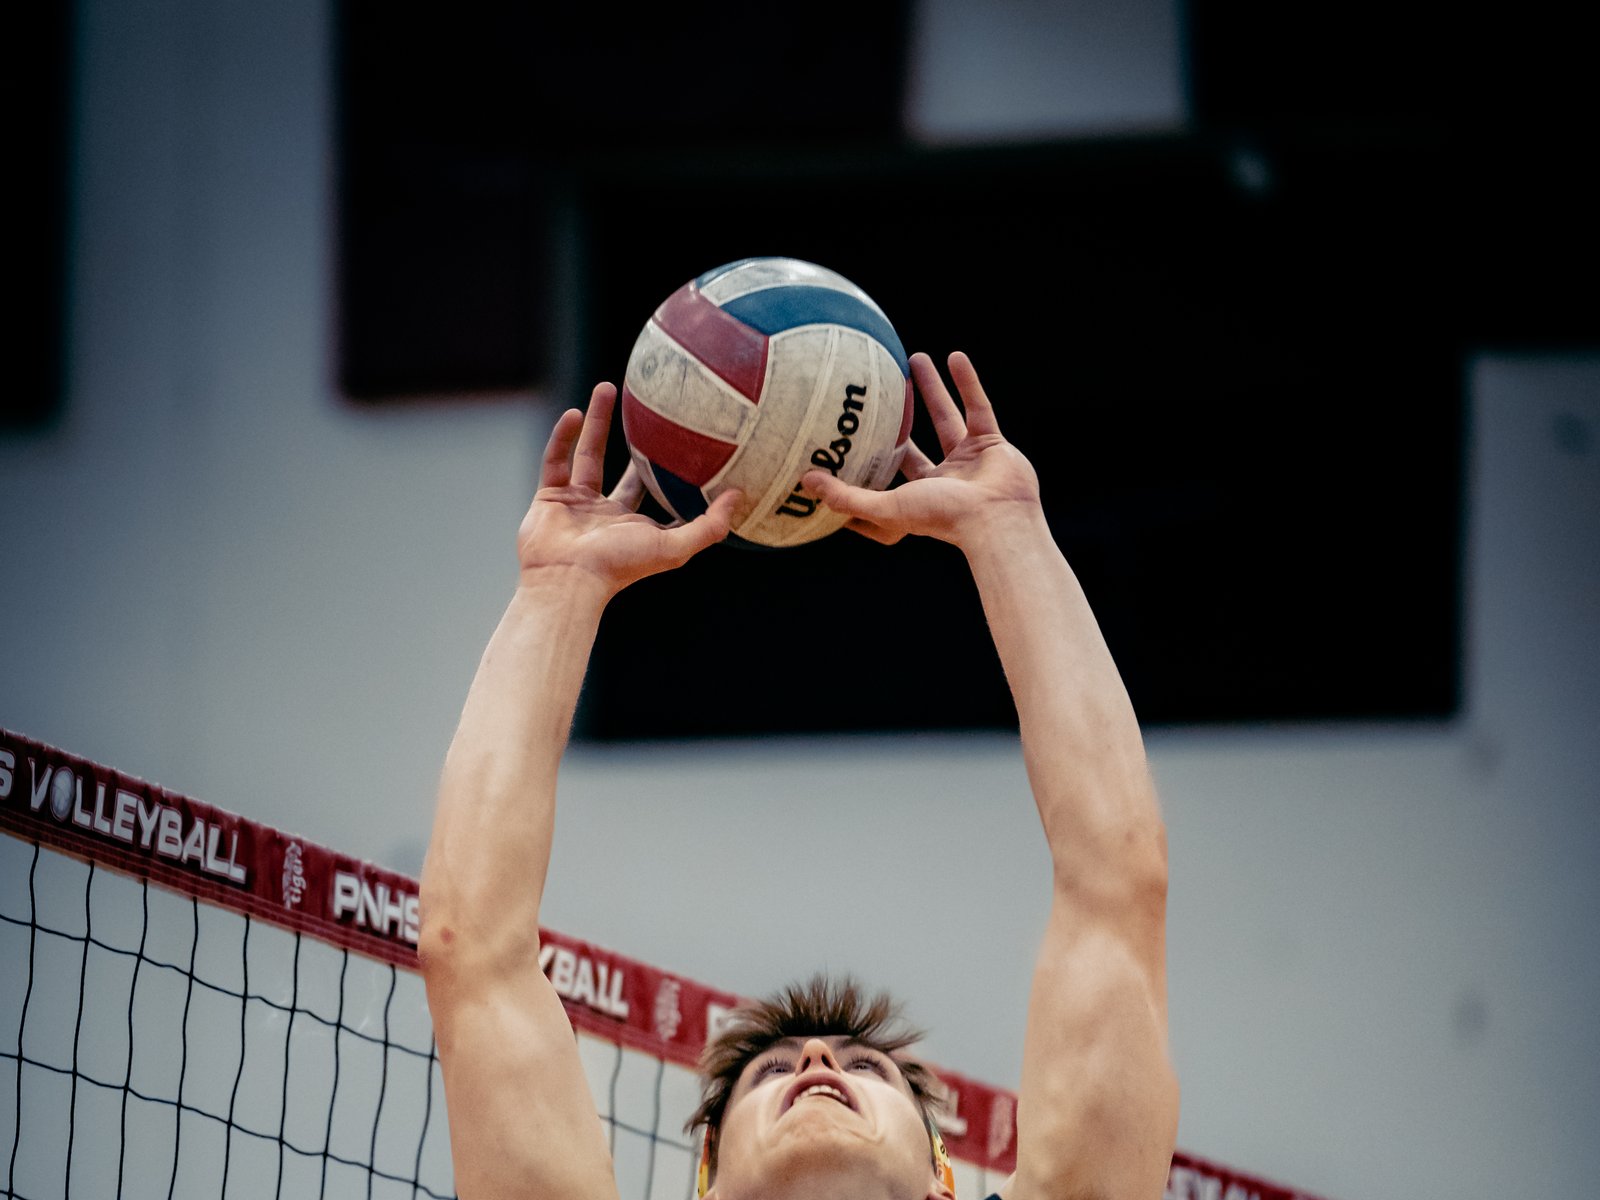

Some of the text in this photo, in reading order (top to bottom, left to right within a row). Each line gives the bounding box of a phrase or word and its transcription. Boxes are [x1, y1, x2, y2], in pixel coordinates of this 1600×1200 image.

[776, 383, 867, 518] Wlson
[27, 756, 248, 885] VOLLEYBALL
[332, 871, 420, 944] PNHS
